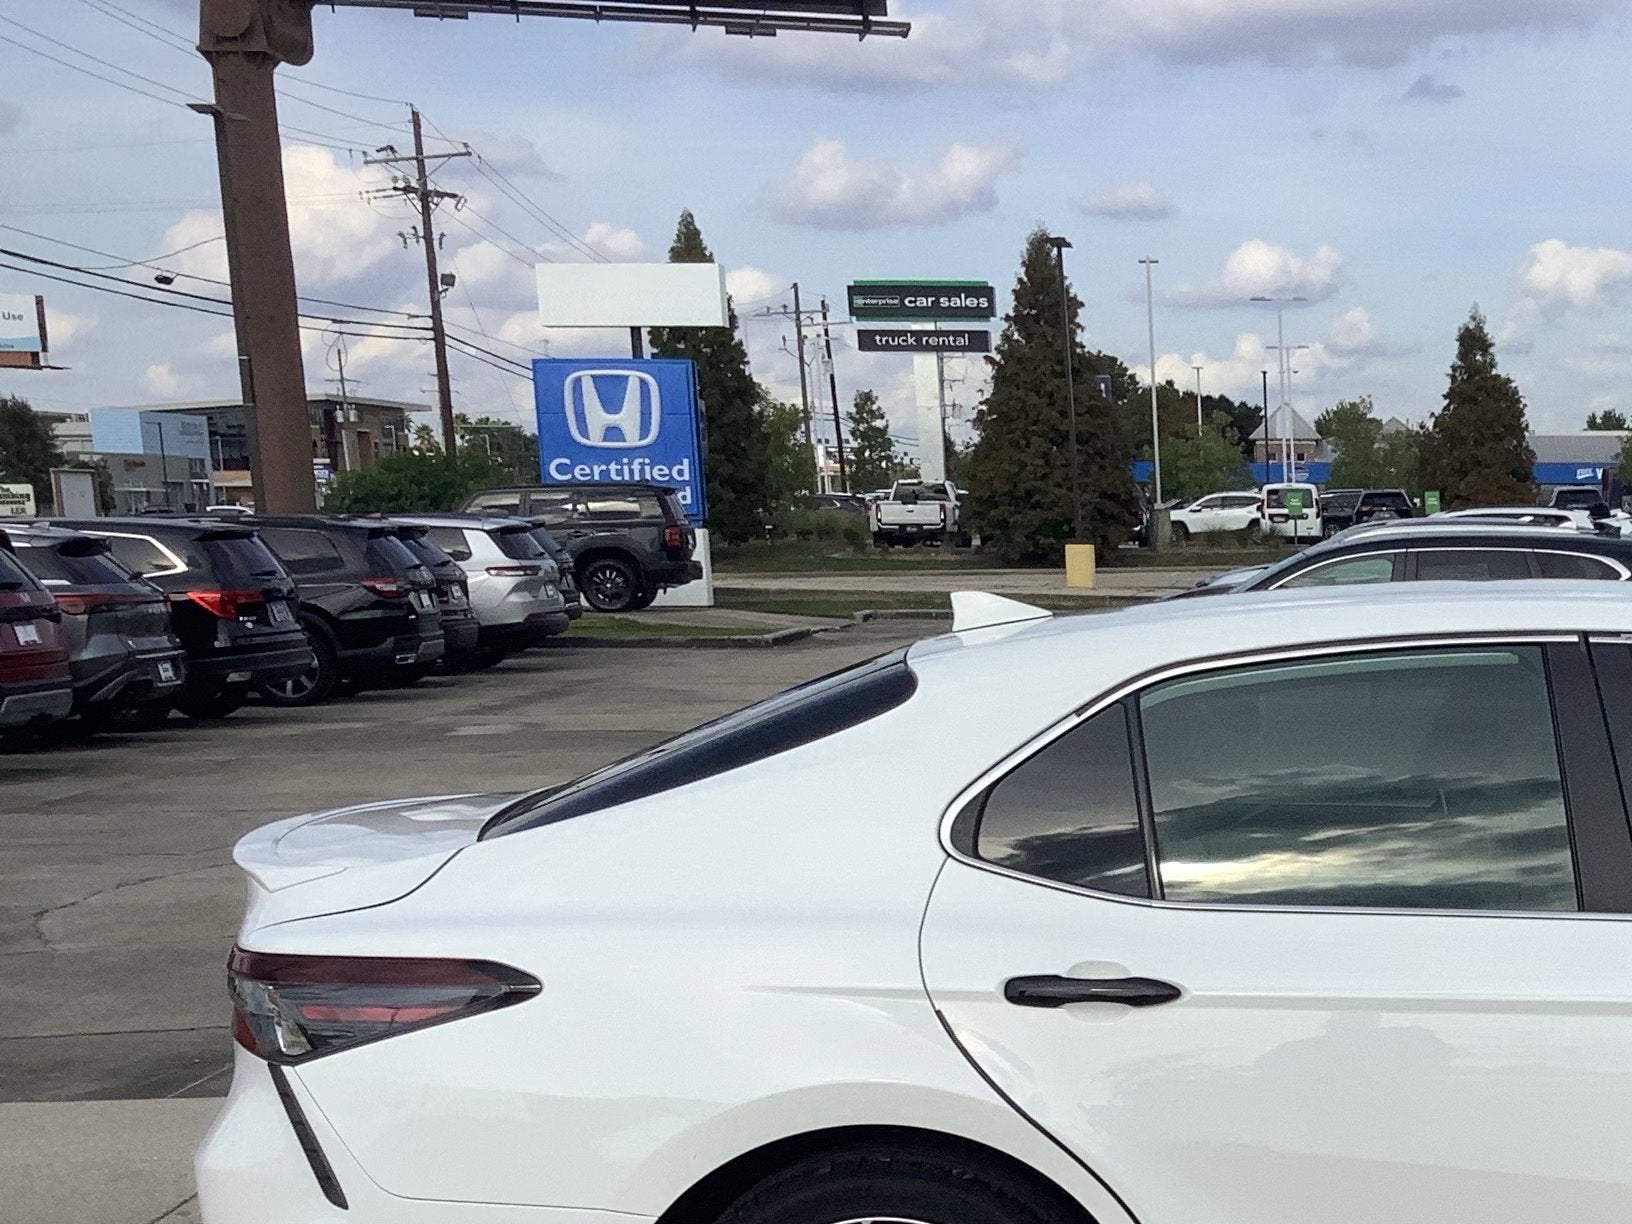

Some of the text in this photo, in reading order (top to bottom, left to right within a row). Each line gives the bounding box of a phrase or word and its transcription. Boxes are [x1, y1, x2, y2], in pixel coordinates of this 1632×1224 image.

[904, 296, 935, 307] car
[940, 293, 989, 307] sales
[2, 312, 24, 320] Use
[874, 333, 969, 346] truck rental
[549, 457, 690, 481] Certified
